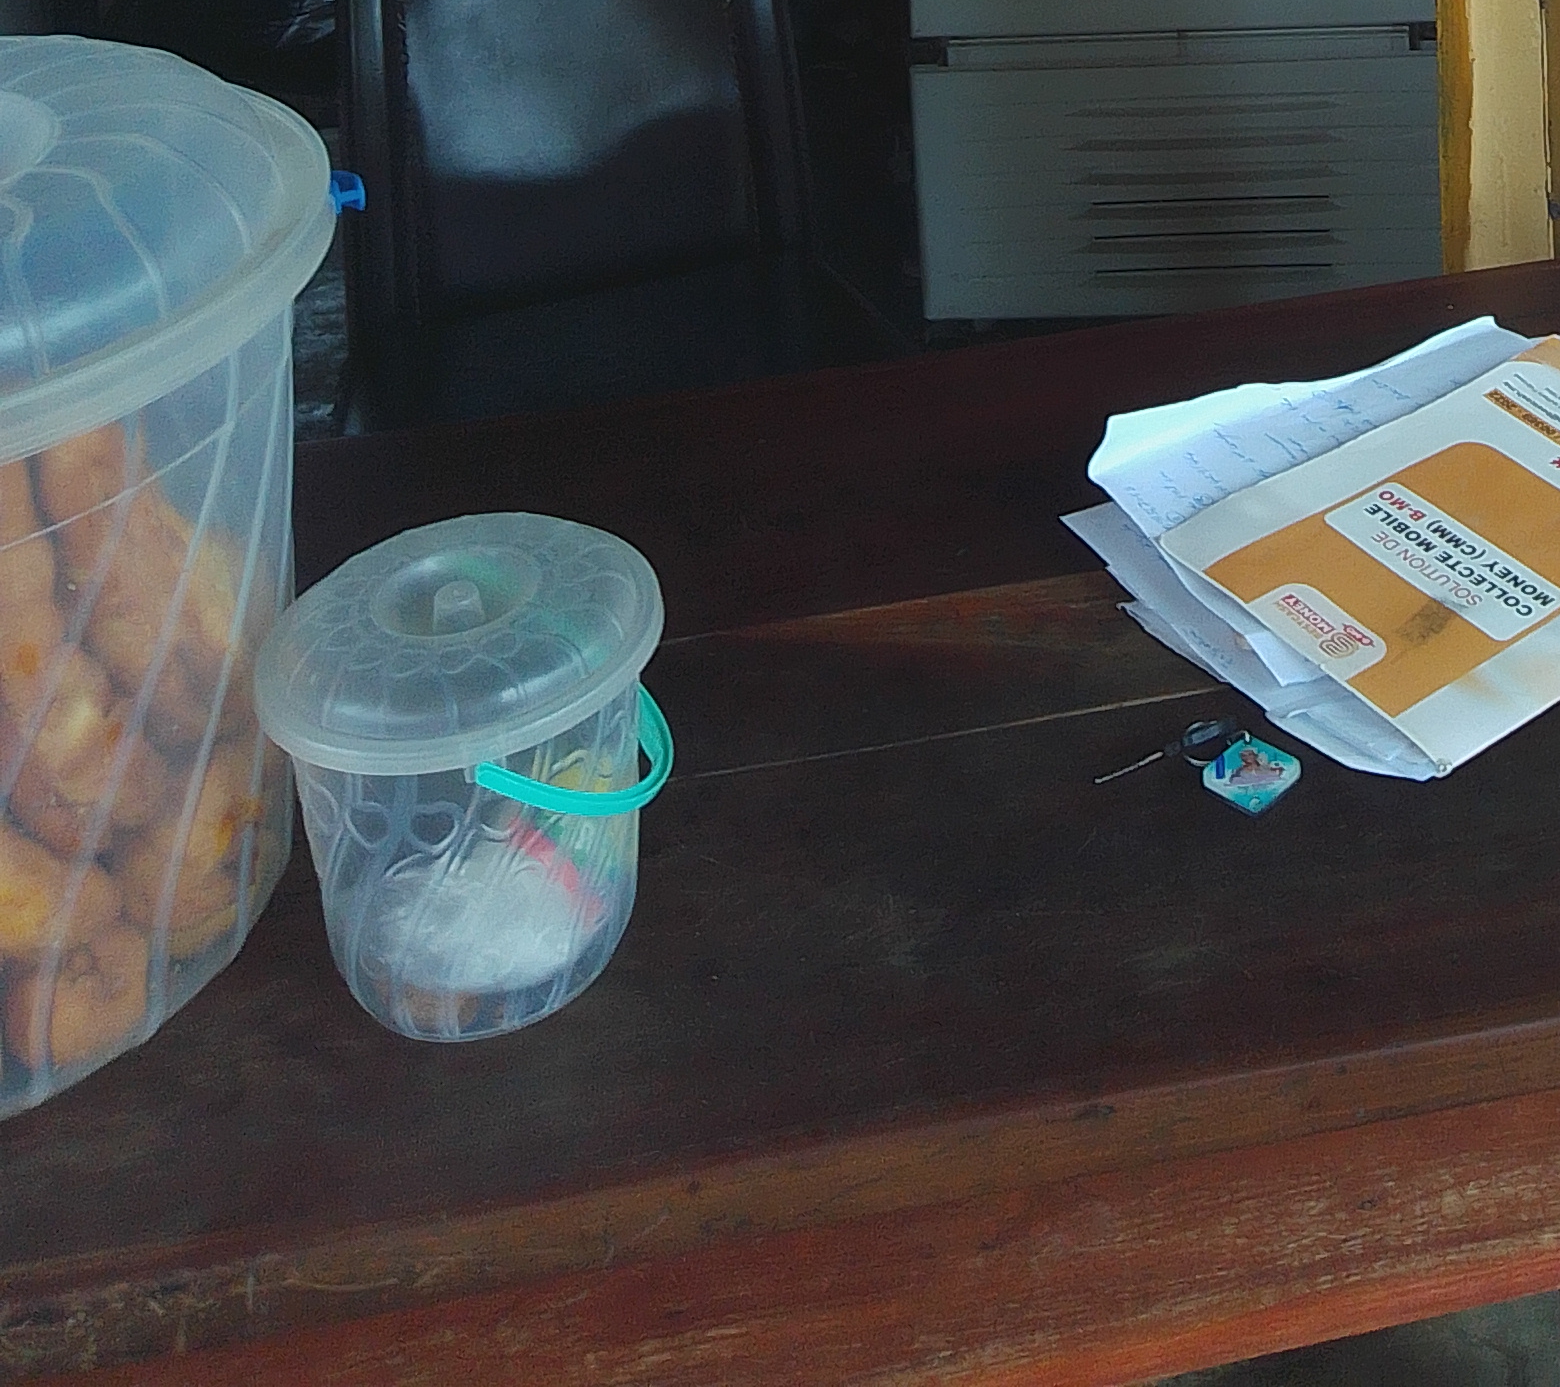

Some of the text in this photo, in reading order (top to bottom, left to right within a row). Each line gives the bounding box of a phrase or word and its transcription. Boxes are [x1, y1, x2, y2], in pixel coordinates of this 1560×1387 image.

[1363, 503, 1534, 618] COLLECTE MOBILE
[1371, 530, 1483, 608] SOLUTION DE
[1378, 490, 1556, 607] MONEY (CMM) B-MO
